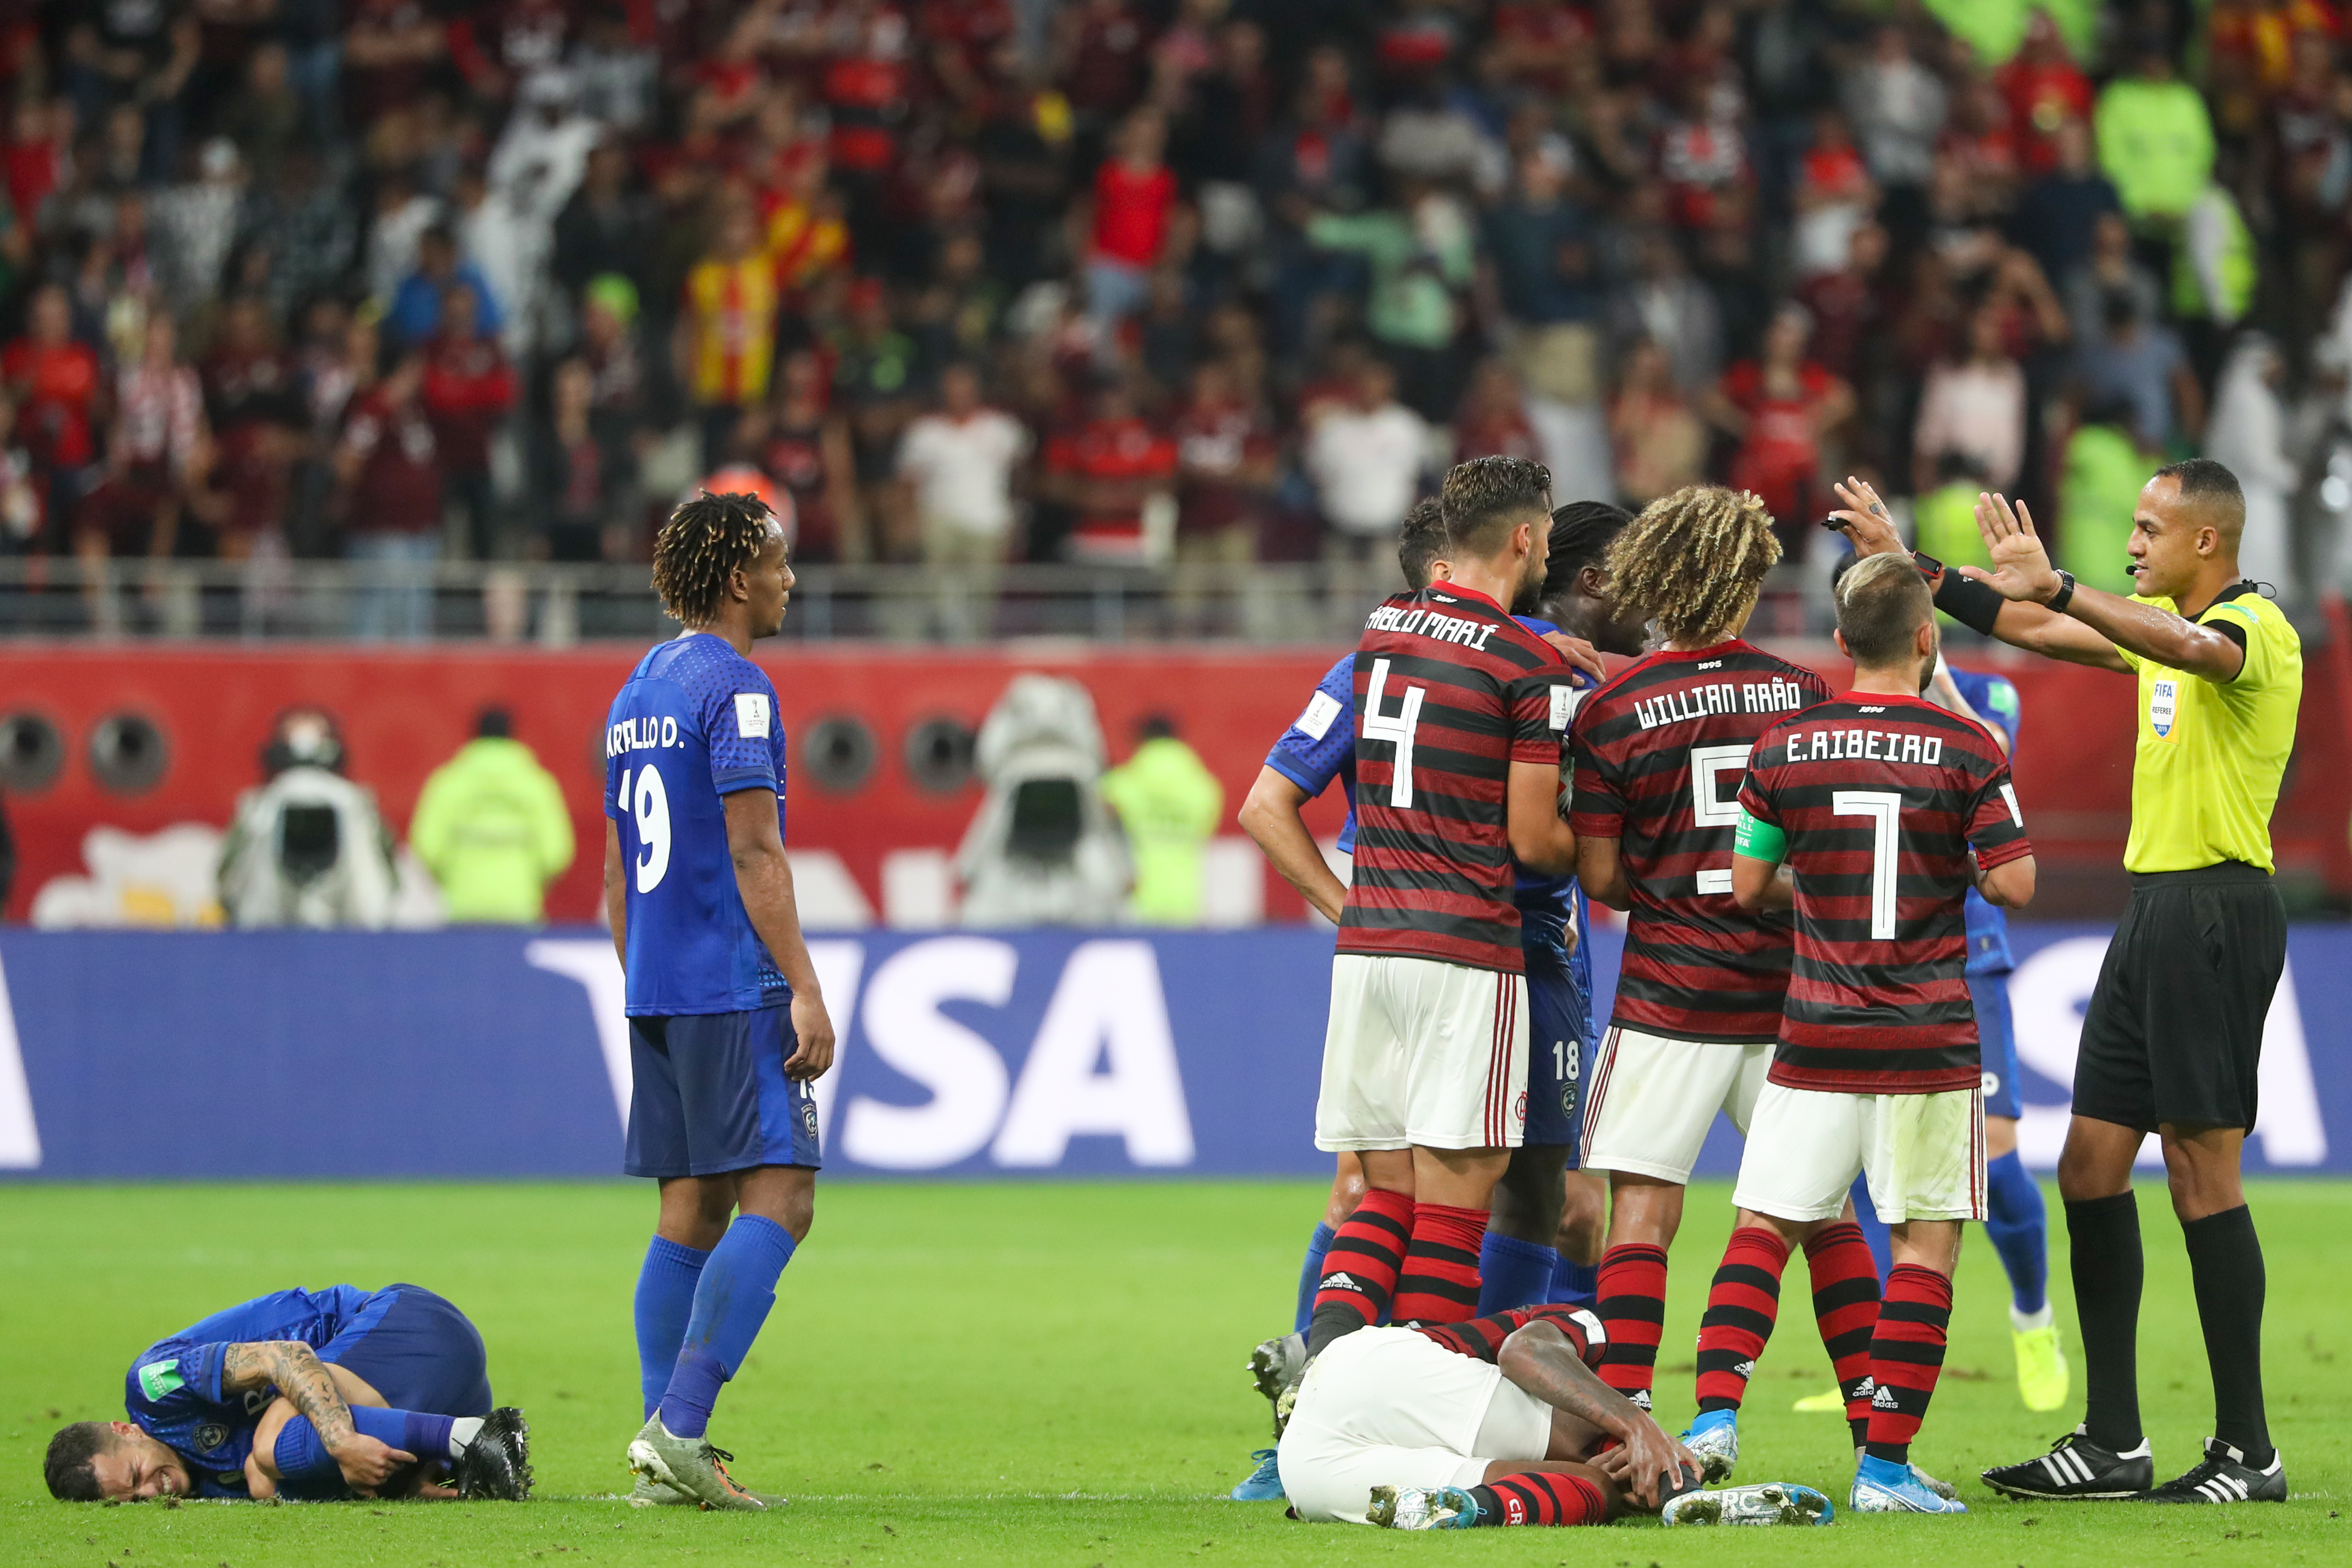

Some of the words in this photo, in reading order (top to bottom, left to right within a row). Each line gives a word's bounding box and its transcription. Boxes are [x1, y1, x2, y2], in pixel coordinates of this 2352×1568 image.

[1418, 612, 1500, 652] MARÍ
[1697, 660, 1722, 670] 1895
[1634, 684, 1736, 729] WILLIAN
[1743, 677, 1800, 713] ARÃO
[2154, 684, 2173, 698] FIFA
[2152, 706, 2171, 715] REFEREE
[662, 716, 685, 749] D.
[1363, 658, 1426, 808] 4
[1787, 729, 1942, 765] E.RIBEIRO
[1832, 791, 1901, 939] 7
[1552, 1041, 1580, 1080] 18
